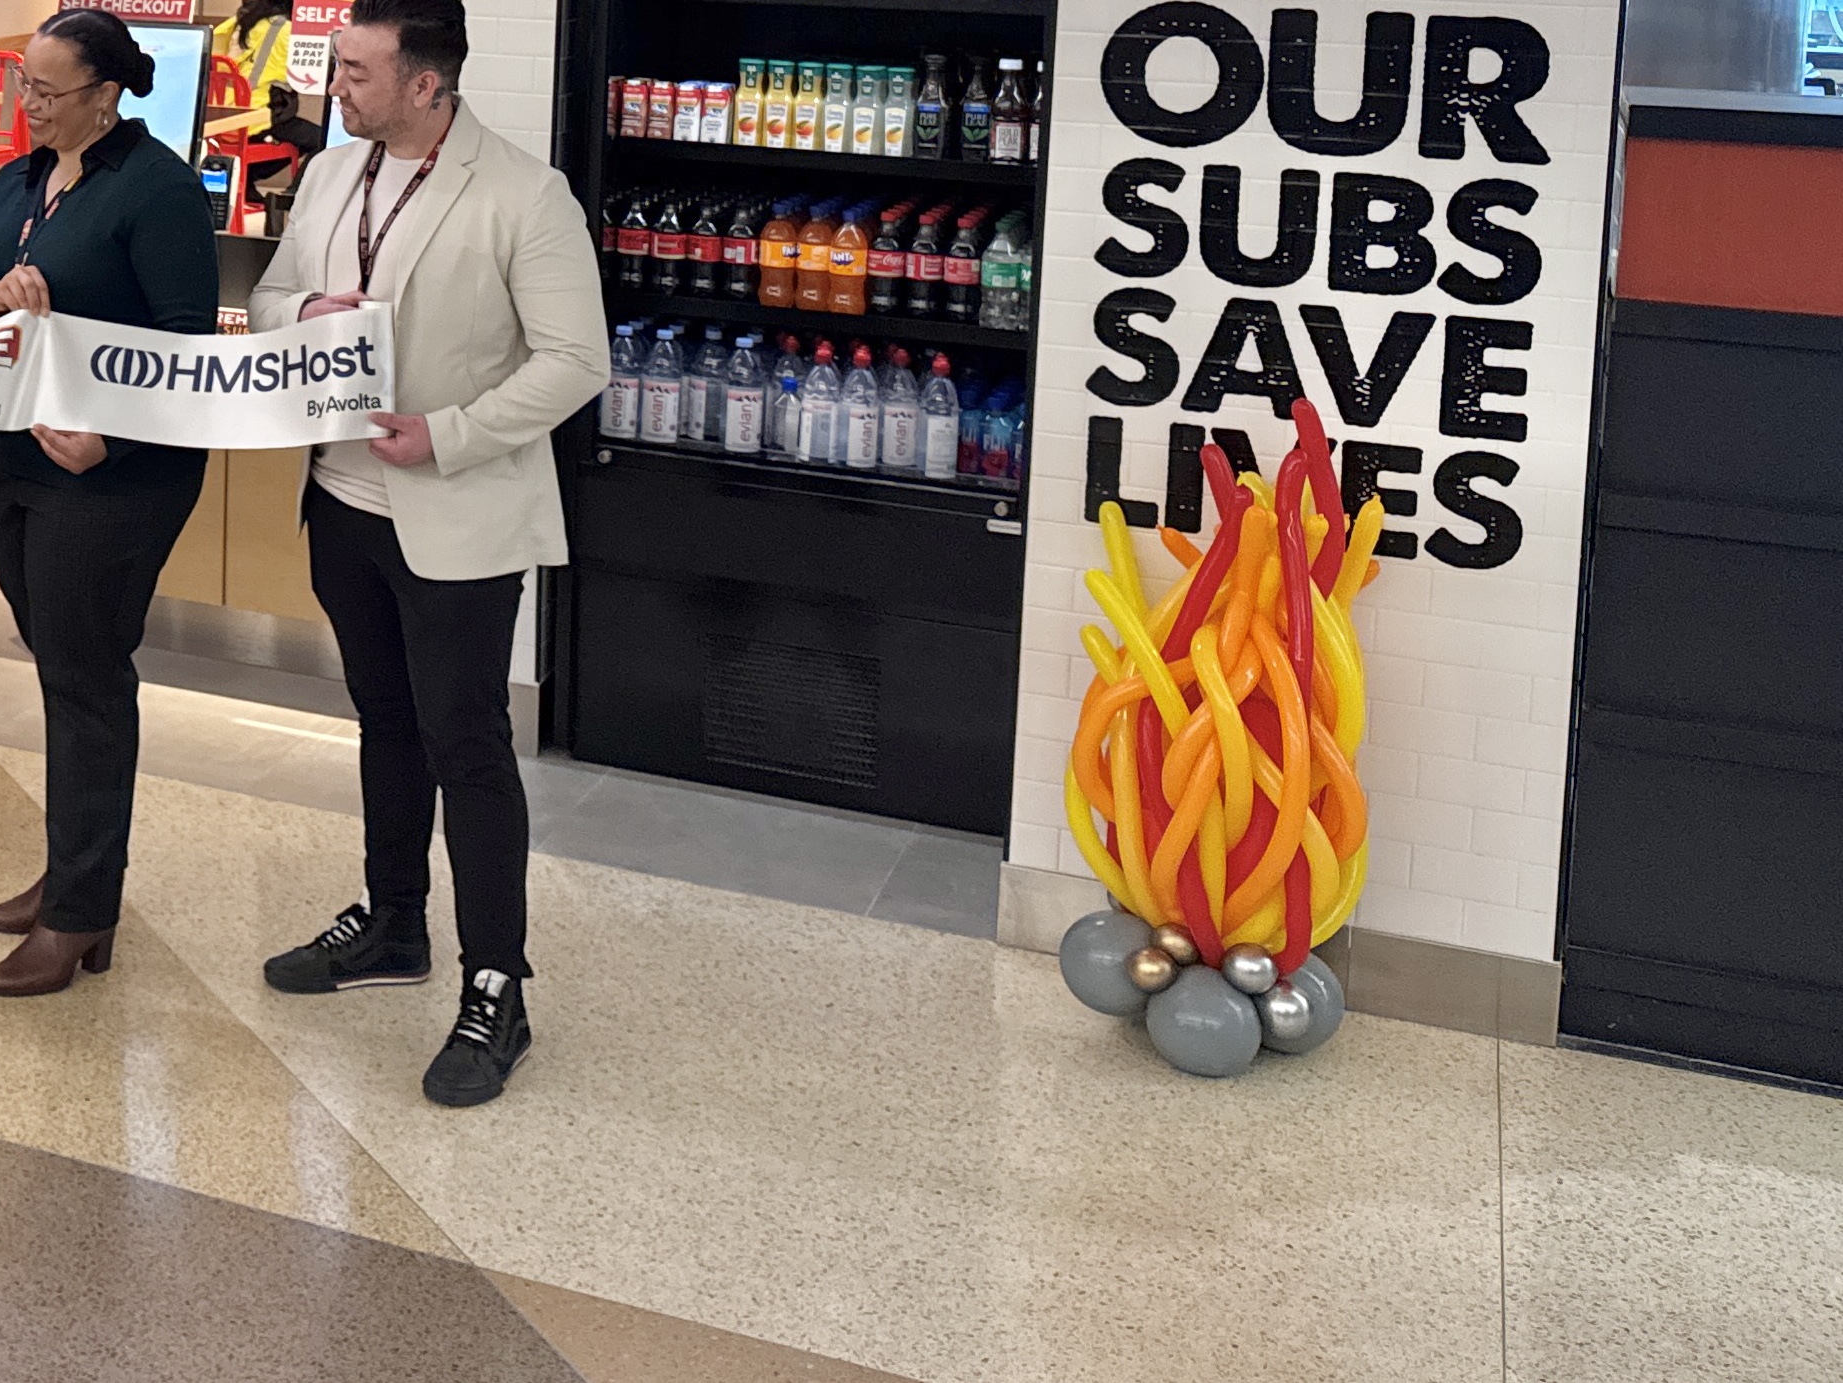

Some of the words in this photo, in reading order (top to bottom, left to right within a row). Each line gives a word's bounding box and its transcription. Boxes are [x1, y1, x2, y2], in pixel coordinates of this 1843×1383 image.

[296, 6, 337, 23] SELF
[292, 58, 323, 67] HERE
[293, 41, 325, 49] ORDER
[303, 50, 324, 58] PAY
[1101, 1, 1550, 164] OUR
[1094, 158, 1542, 305] SUBS
[167, 336, 376, 393] HMSHost
[1085, 287, 1534, 441] SAVE
